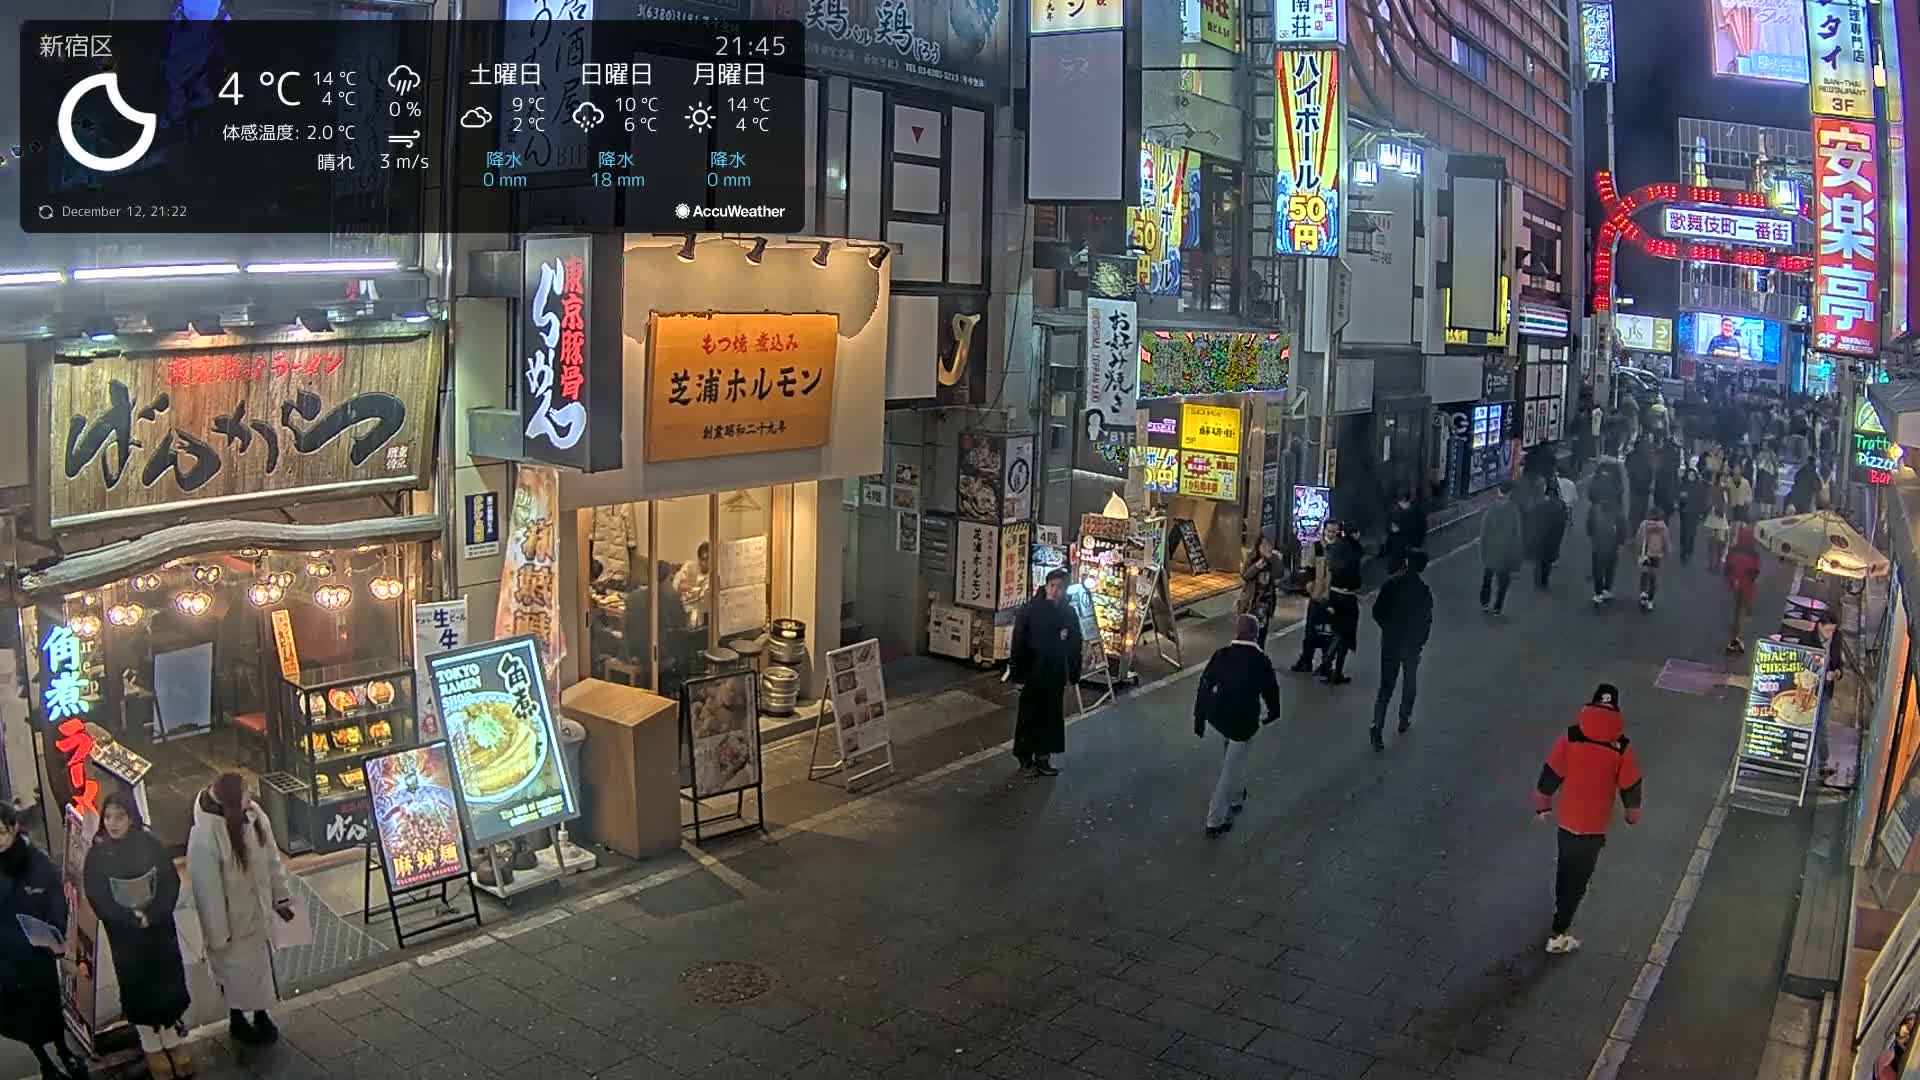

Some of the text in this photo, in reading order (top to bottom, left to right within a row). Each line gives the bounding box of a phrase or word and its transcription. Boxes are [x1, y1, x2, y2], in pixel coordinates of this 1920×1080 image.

[1295, 54, 1320, 190] ハイボール
[1832, 98, 1855, 111] 3F
[1669, 210, 1789, 243] 歌舞伎町一番街
[1816, 126, 1876, 331] 安楽亭
[668, 366, 823, 405] 芝浦ホルモン
[1104, 308, 1134, 414] お好み焼き
[43, 624, 91, 722] 角煮
[436, 663, 480, 684] TOKYO
[438, 677, 482, 696] RAMEN
[498, 654, 542, 720] 角煮
